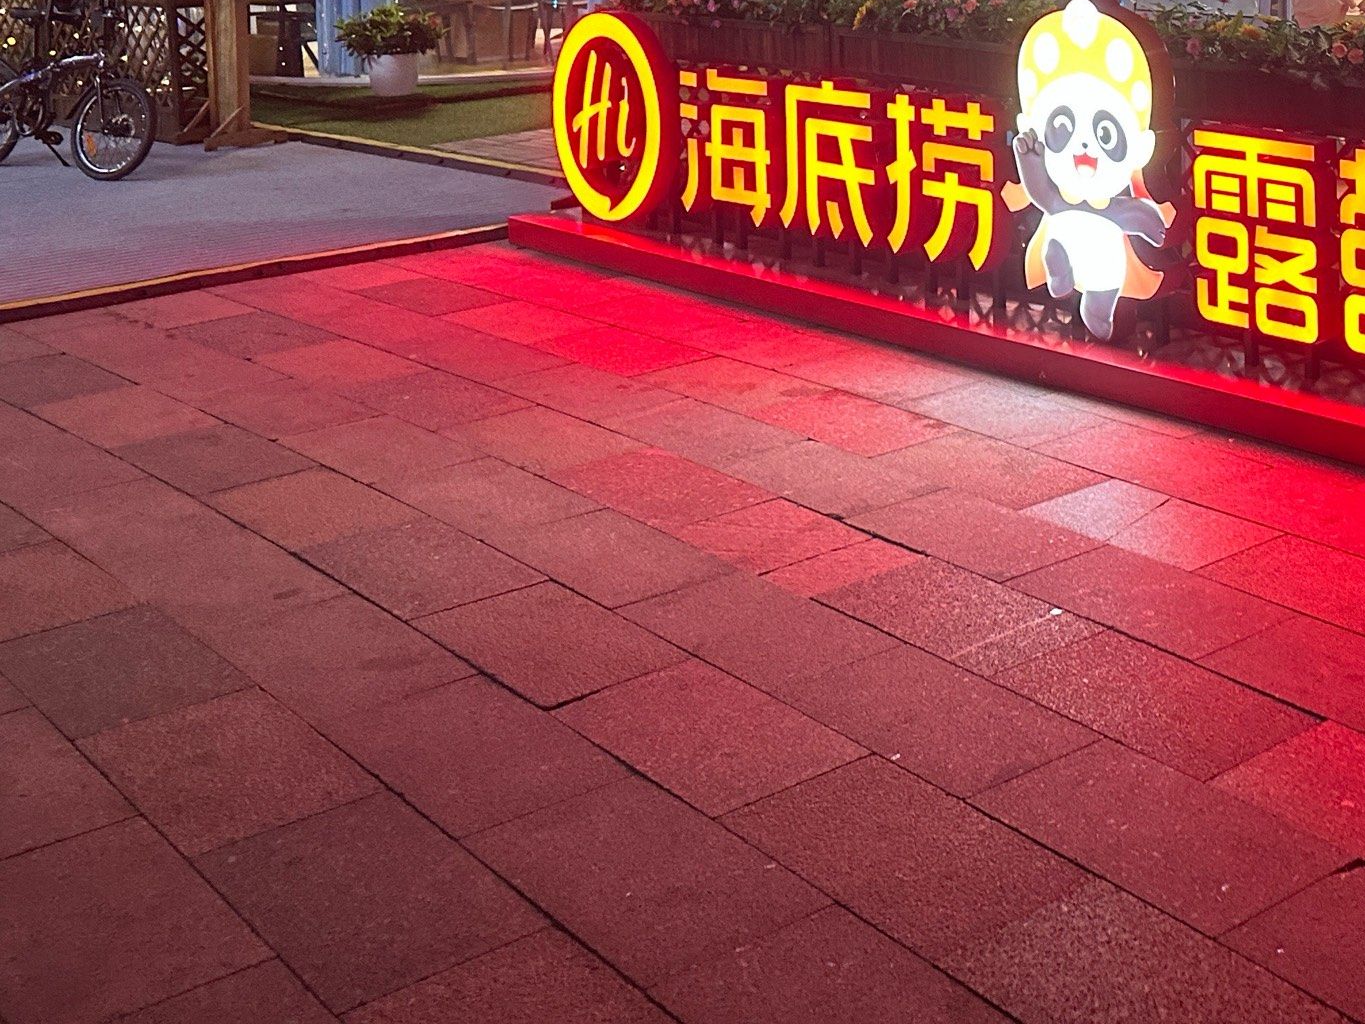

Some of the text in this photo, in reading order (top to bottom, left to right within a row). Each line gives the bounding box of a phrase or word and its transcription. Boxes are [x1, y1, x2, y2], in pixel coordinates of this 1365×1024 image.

[572, 49, 637, 169] Hi
[679, 68, 995, 271] 海底捞
